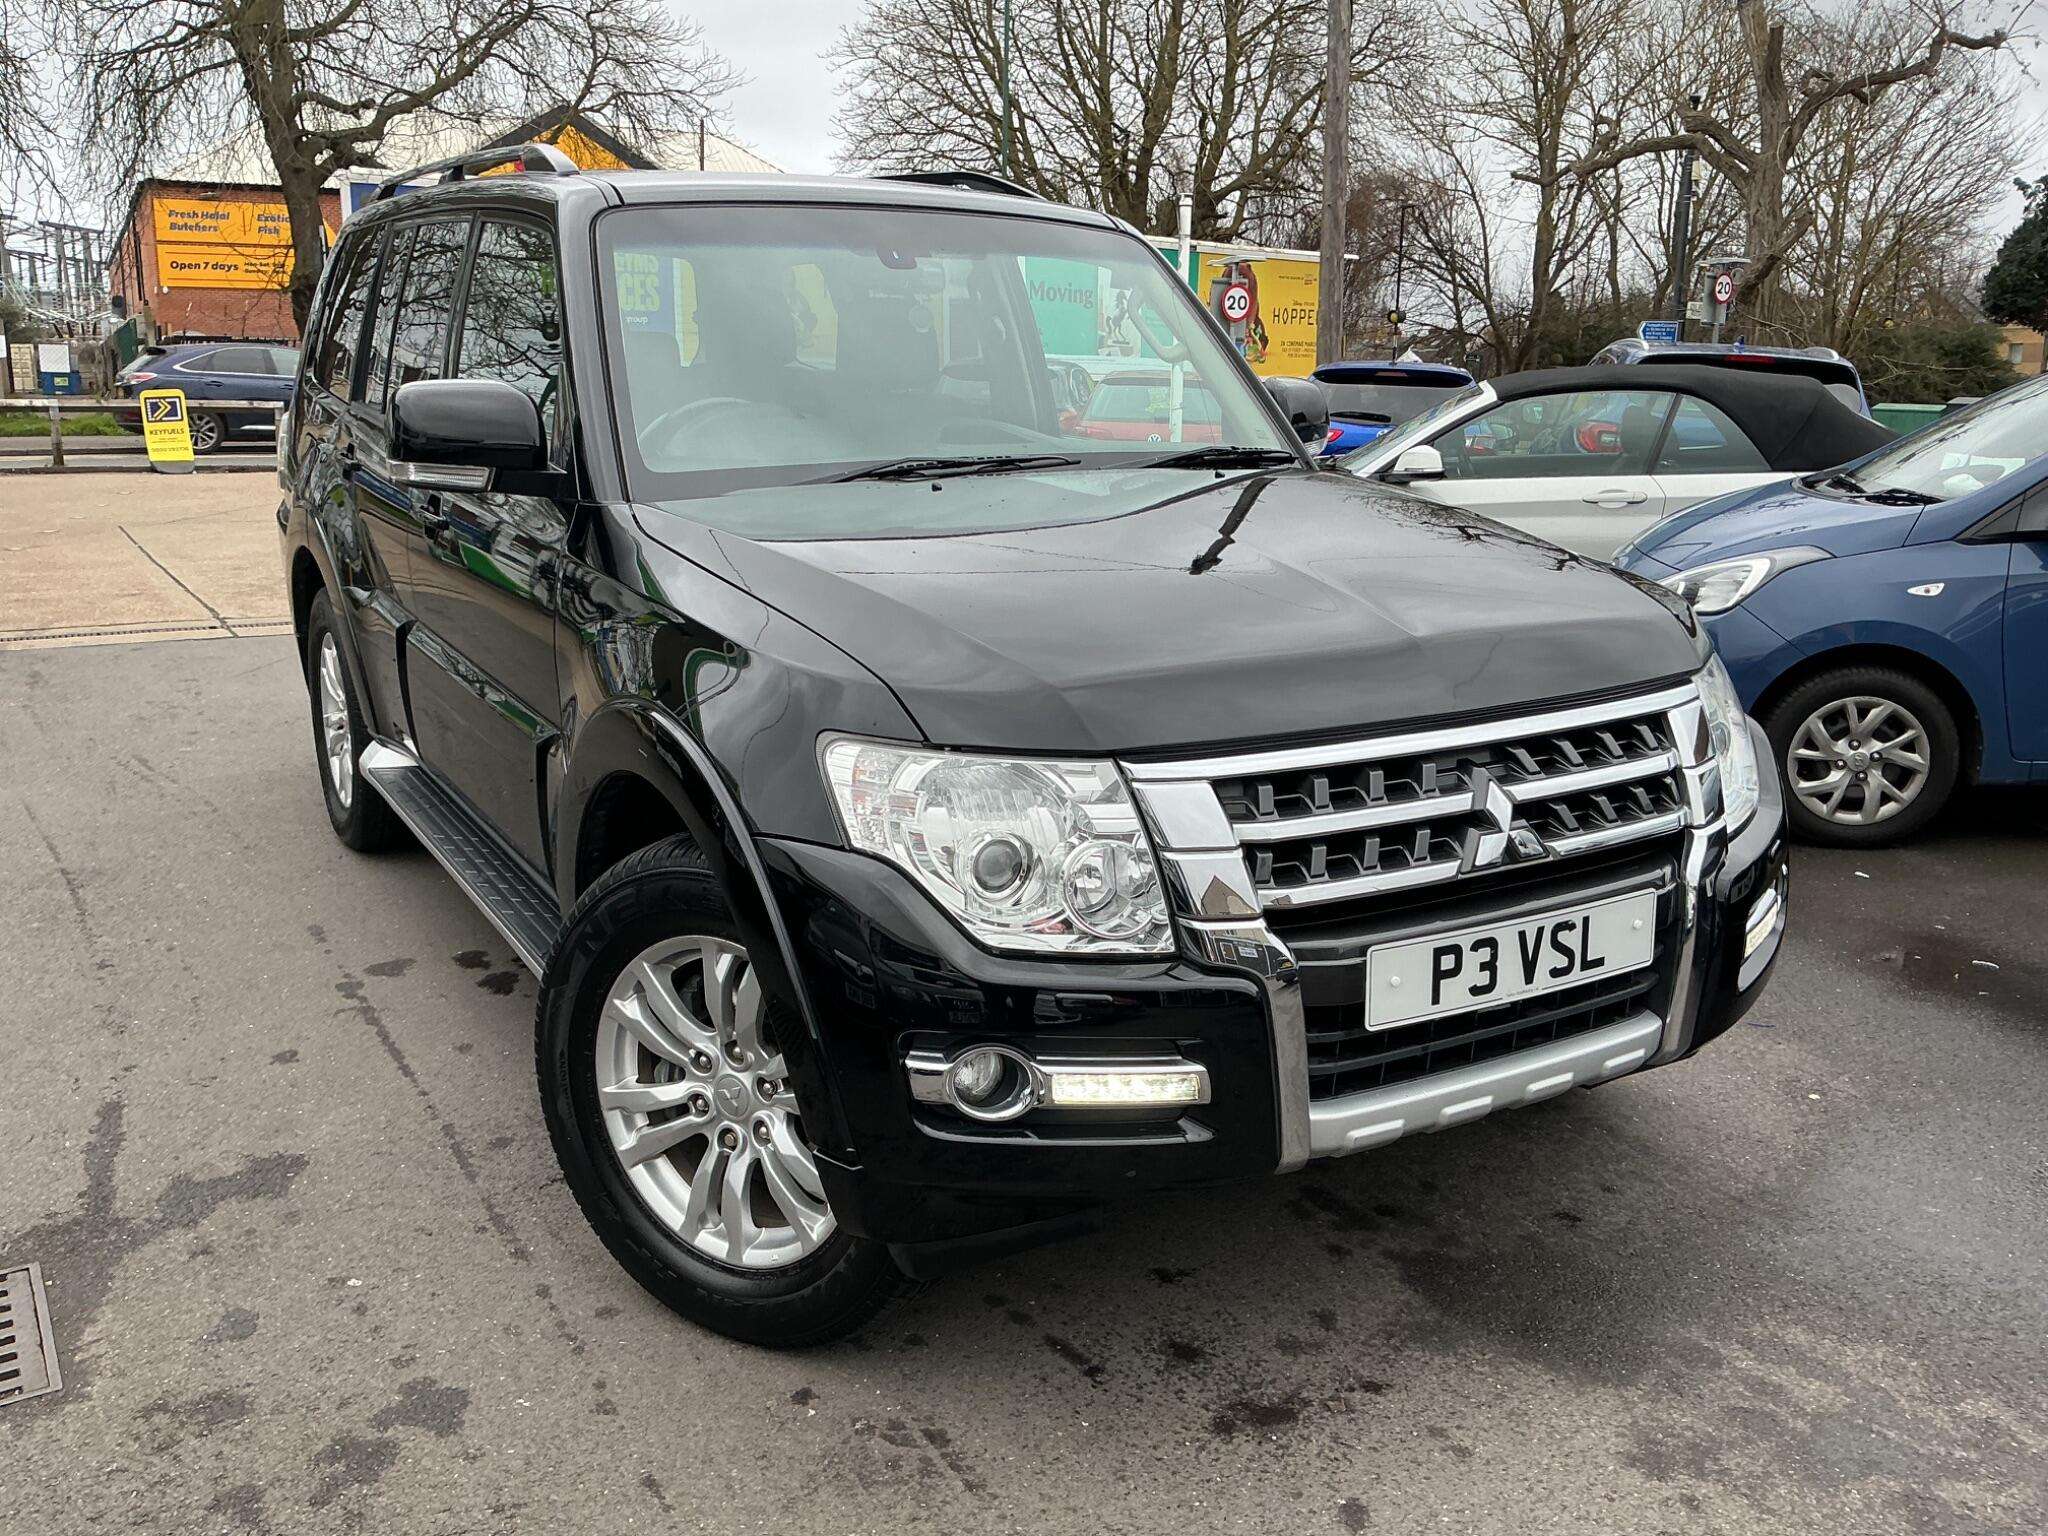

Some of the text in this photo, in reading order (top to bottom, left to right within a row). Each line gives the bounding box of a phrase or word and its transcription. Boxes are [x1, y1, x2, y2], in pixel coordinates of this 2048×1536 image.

[168, 209, 230, 221] Fresh Halal
[169, 222, 219, 233] Butchers
[257, 225, 280, 236] Fish
[170, 260, 239, 272] Open 7 days
[1029, 280, 1094, 309] Moving
[1718, 282, 1730, 295] 20
[1227, 295, 1248, 310] 20
[1273, 307, 1319, 326] HOPPE
[1430, 915, 1606, 1006] P3 VSL
